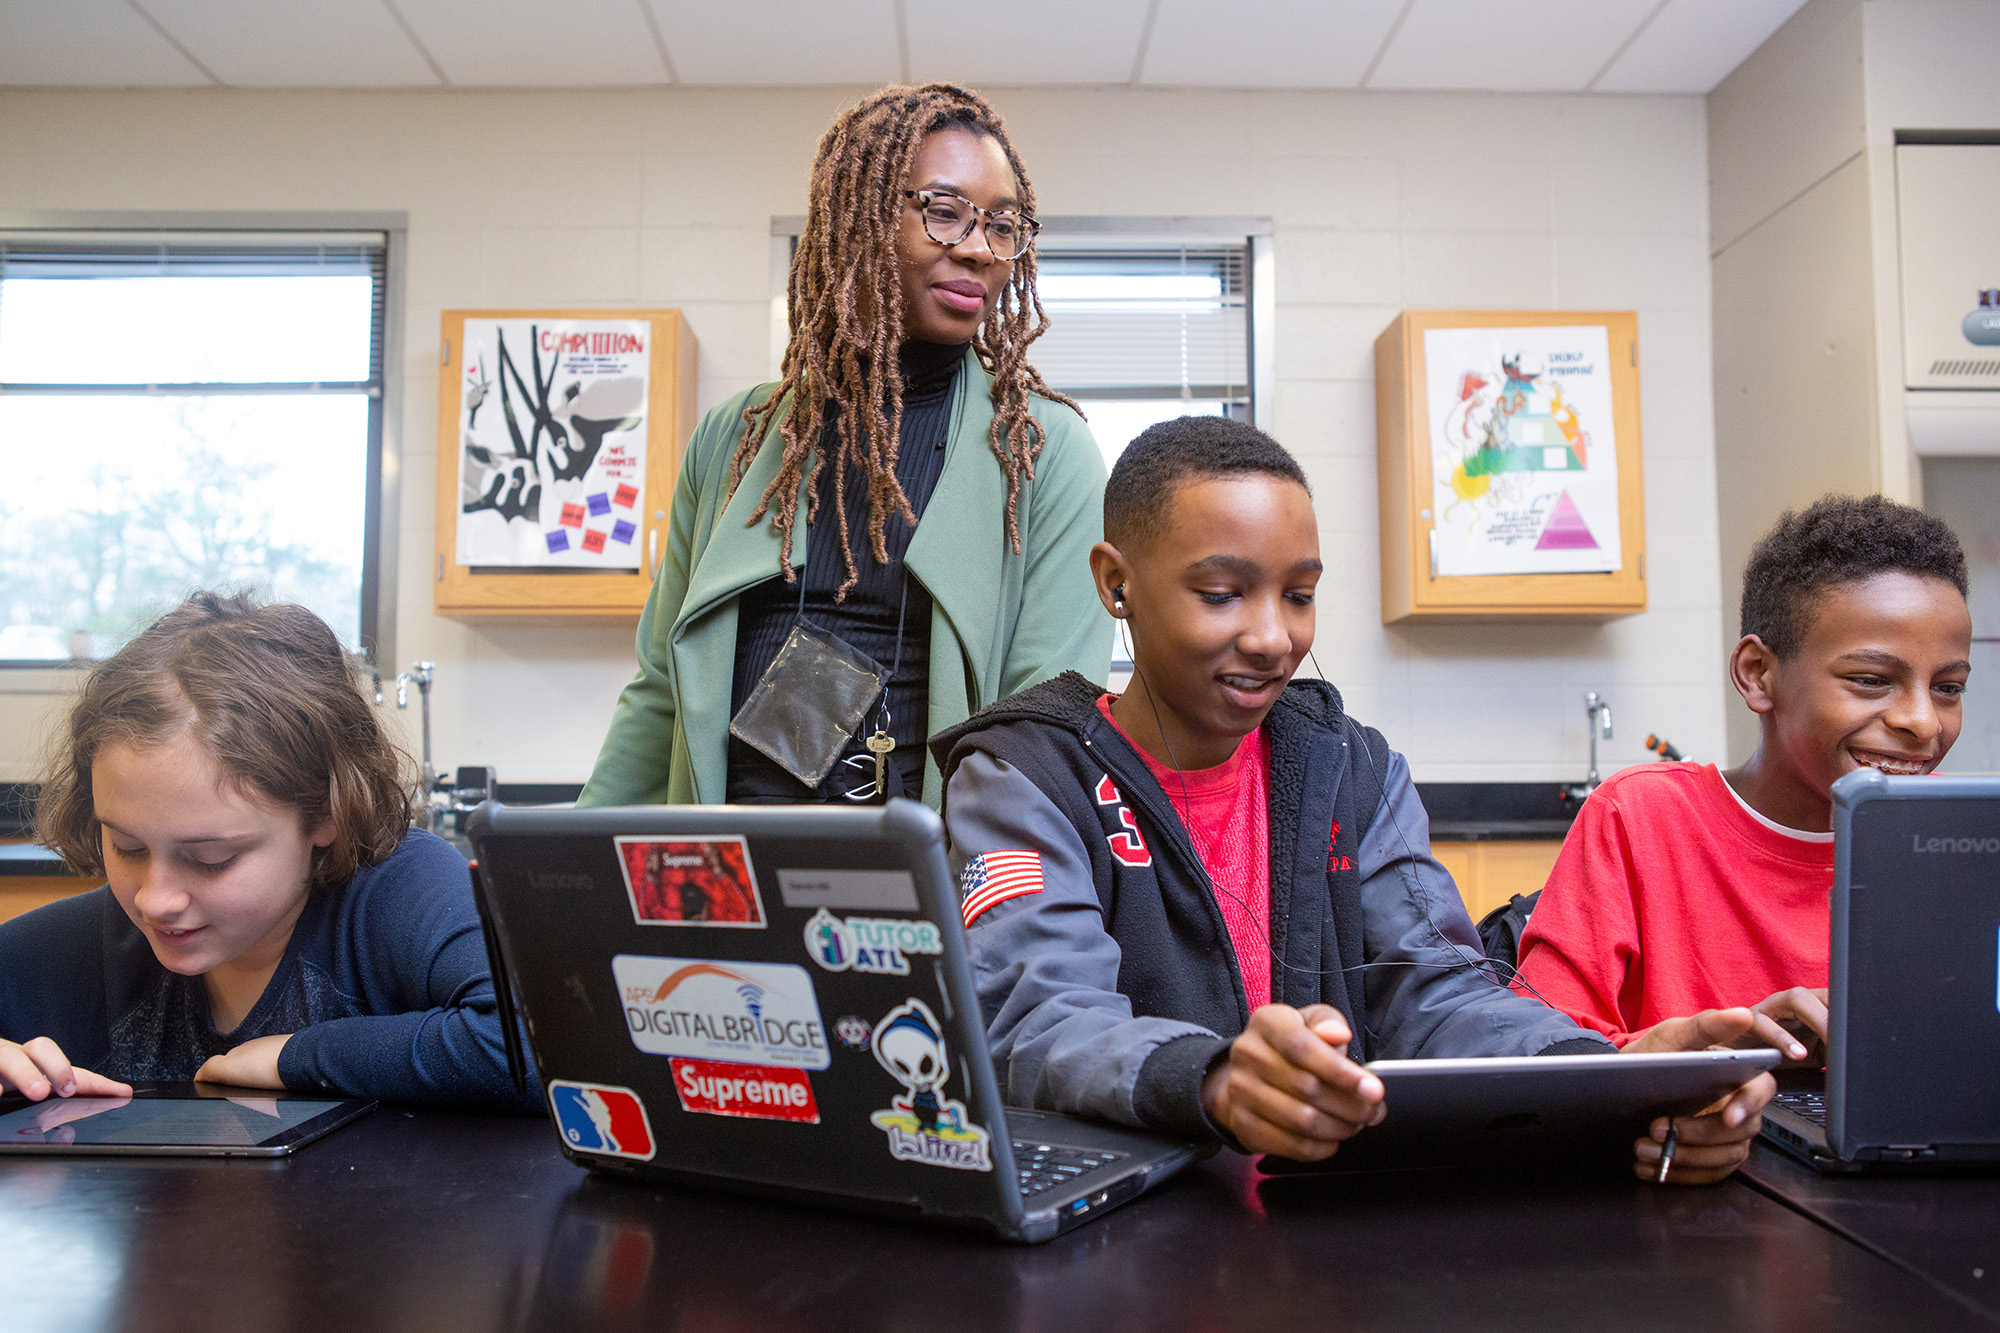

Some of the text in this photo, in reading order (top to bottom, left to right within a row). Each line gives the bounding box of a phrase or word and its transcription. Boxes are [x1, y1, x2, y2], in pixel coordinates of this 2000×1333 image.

[1913, 834, 2000, 853] Lenovo
[662, 853, 703, 868] Supreme
[1326, 855, 1352, 872] PA
[850, 923, 937, 948] TUTOR
[857, 948, 903, 968] ATL
[627, 1007, 824, 1049] DIGITALBRIDGE
[681, 1065, 808, 1108] Supreme
[889, 1125, 986, 1166] blind
